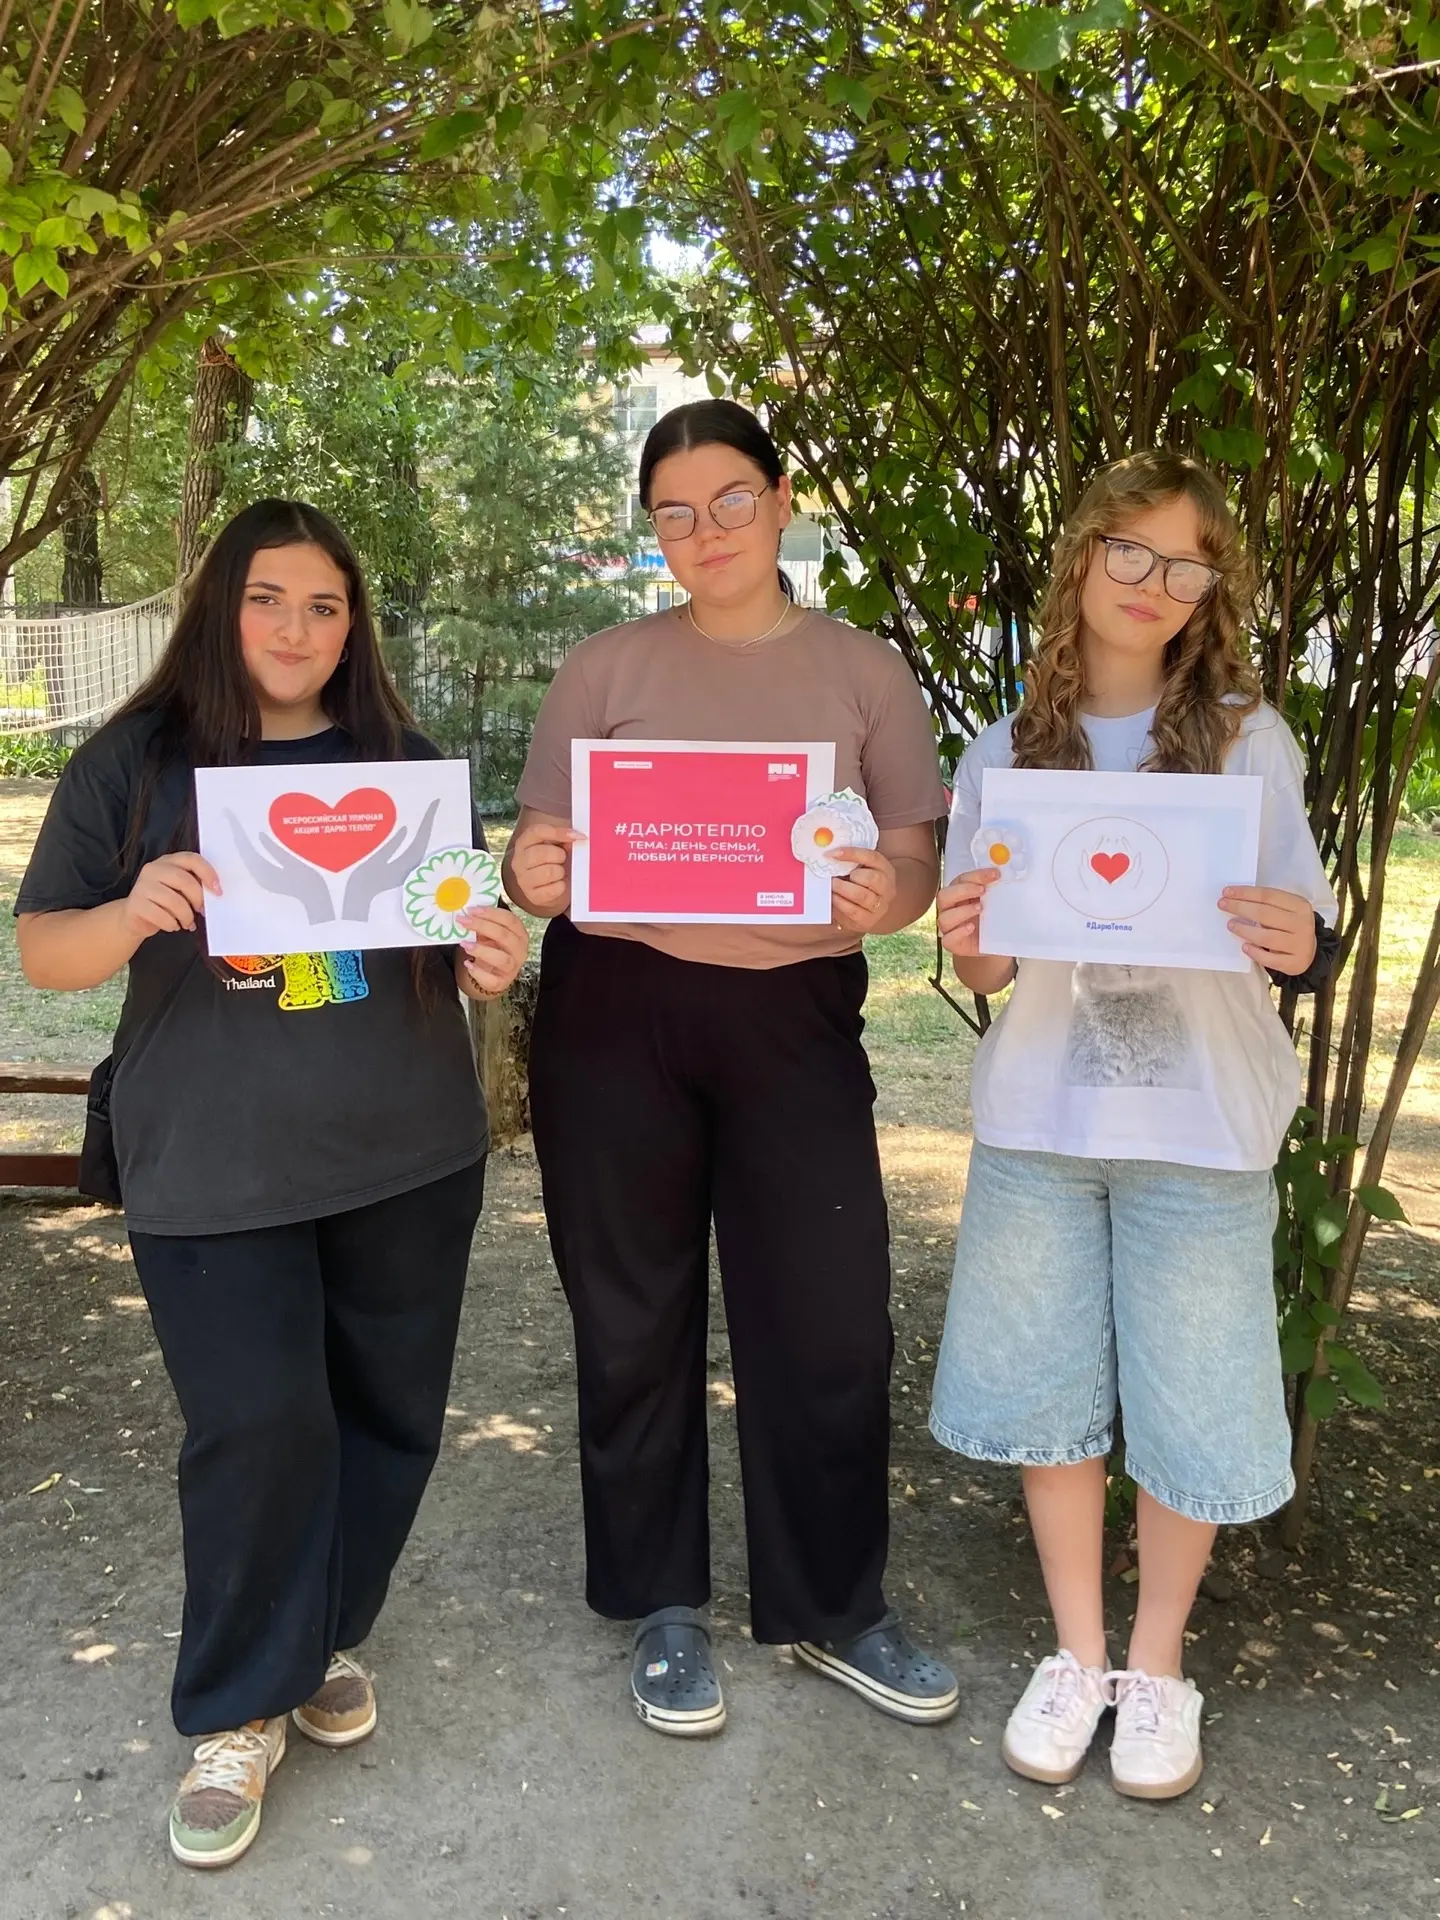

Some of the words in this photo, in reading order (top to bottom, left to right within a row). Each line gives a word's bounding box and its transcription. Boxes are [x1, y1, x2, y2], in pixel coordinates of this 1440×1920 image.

[283, 814, 347, 824] ВСЕРОССИЙСКАЯ
[294, 827, 320, 835] АКЦИЯ
[321, 825, 347, 834] "ДАРЮ
[348, 823, 376, 831] ТЕПЛО"
[614, 823, 766, 837] #ДАРЮТЕПЛО
[628, 841, 668, 850] ТЕМА:
[671, 841, 707, 850] ДЕНЬ
[710, 842, 760, 852] СЕМЬИ,
[628, 852, 676, 862] ЛЮБВИ
[680, 853, 690, 862] И
[693, 853, 764, 863] ВЕРНОСТИ
[1086, 922, 1133, 931] #ДарюТепло
[222, 975, 276, 990] Thailand
